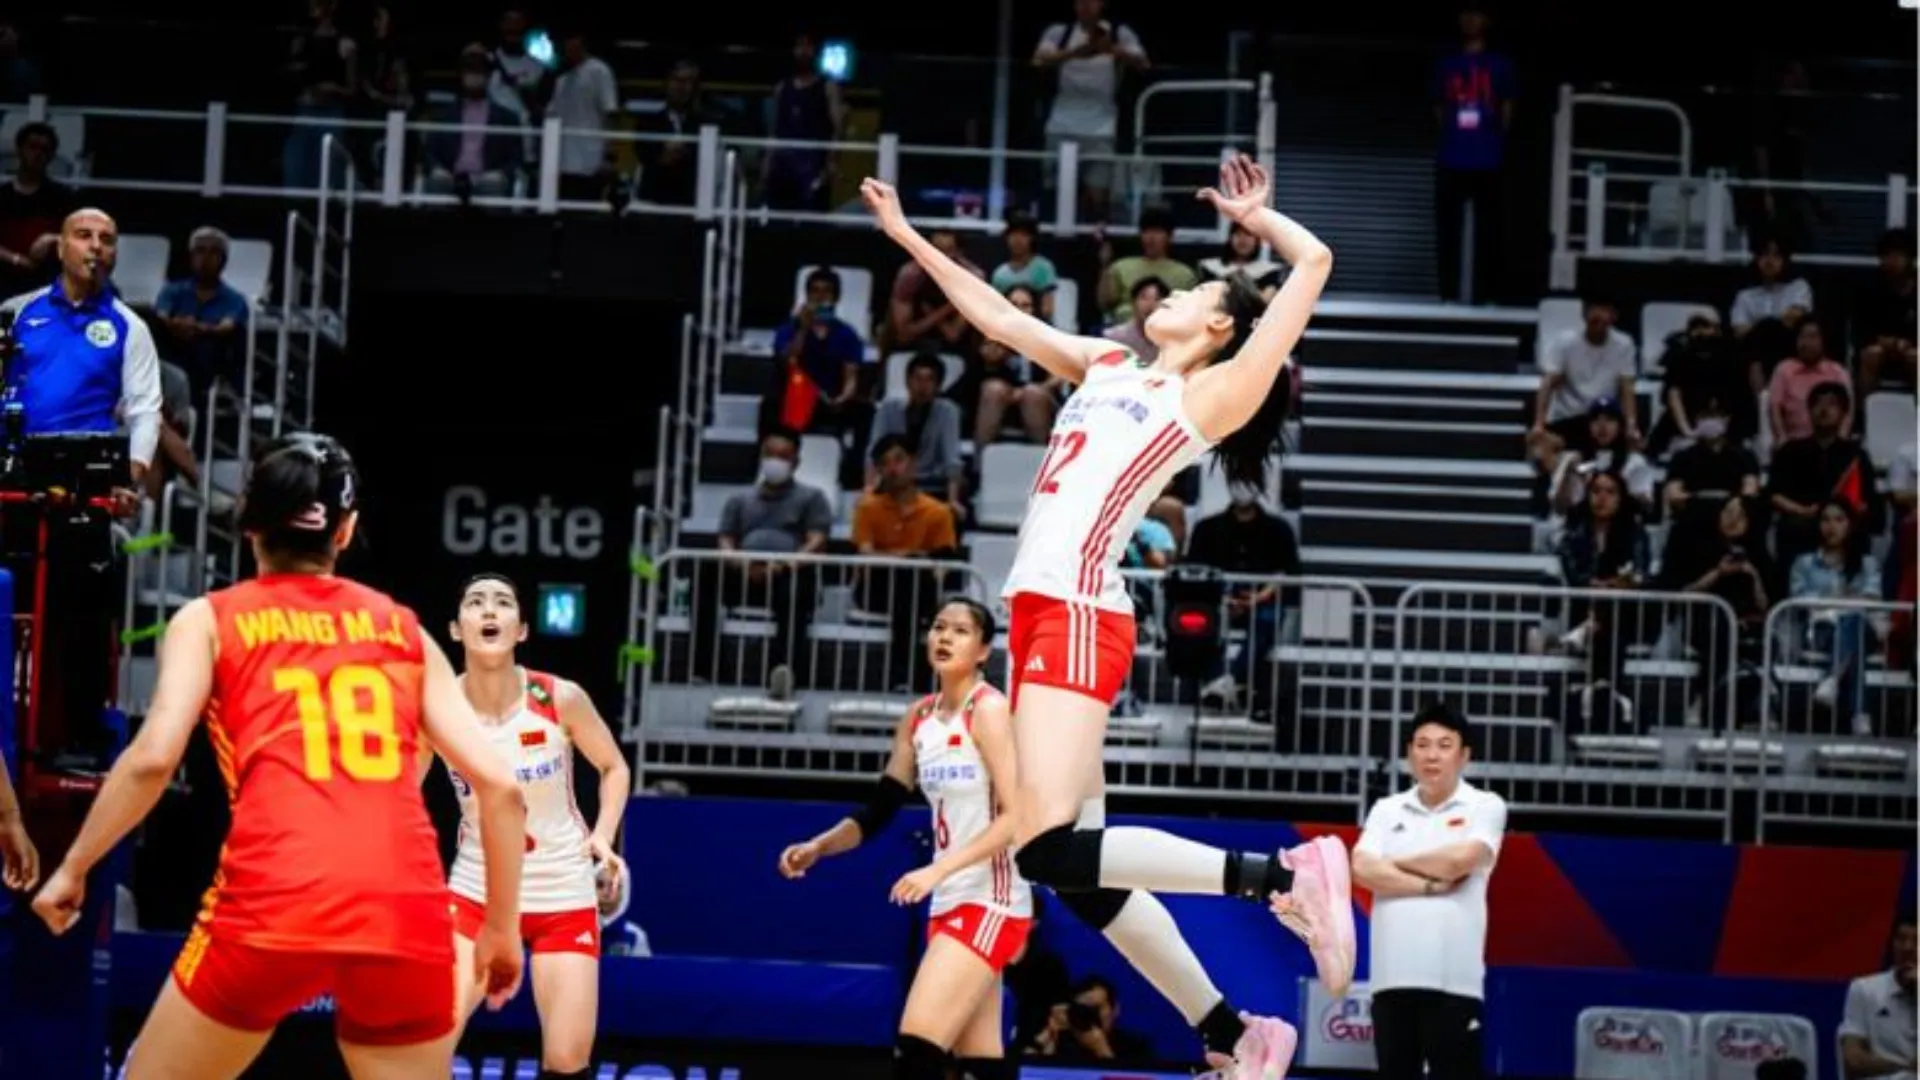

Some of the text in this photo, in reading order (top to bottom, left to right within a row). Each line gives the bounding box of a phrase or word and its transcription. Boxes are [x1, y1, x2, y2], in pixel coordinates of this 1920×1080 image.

[1032, 430, 1087, 495] 12
[443, 486, 603, 558] Gate
[235, 607, 338, 649] WANG
[273, 663, 402, 782] 18
[938, 799, 949, 849] 6
